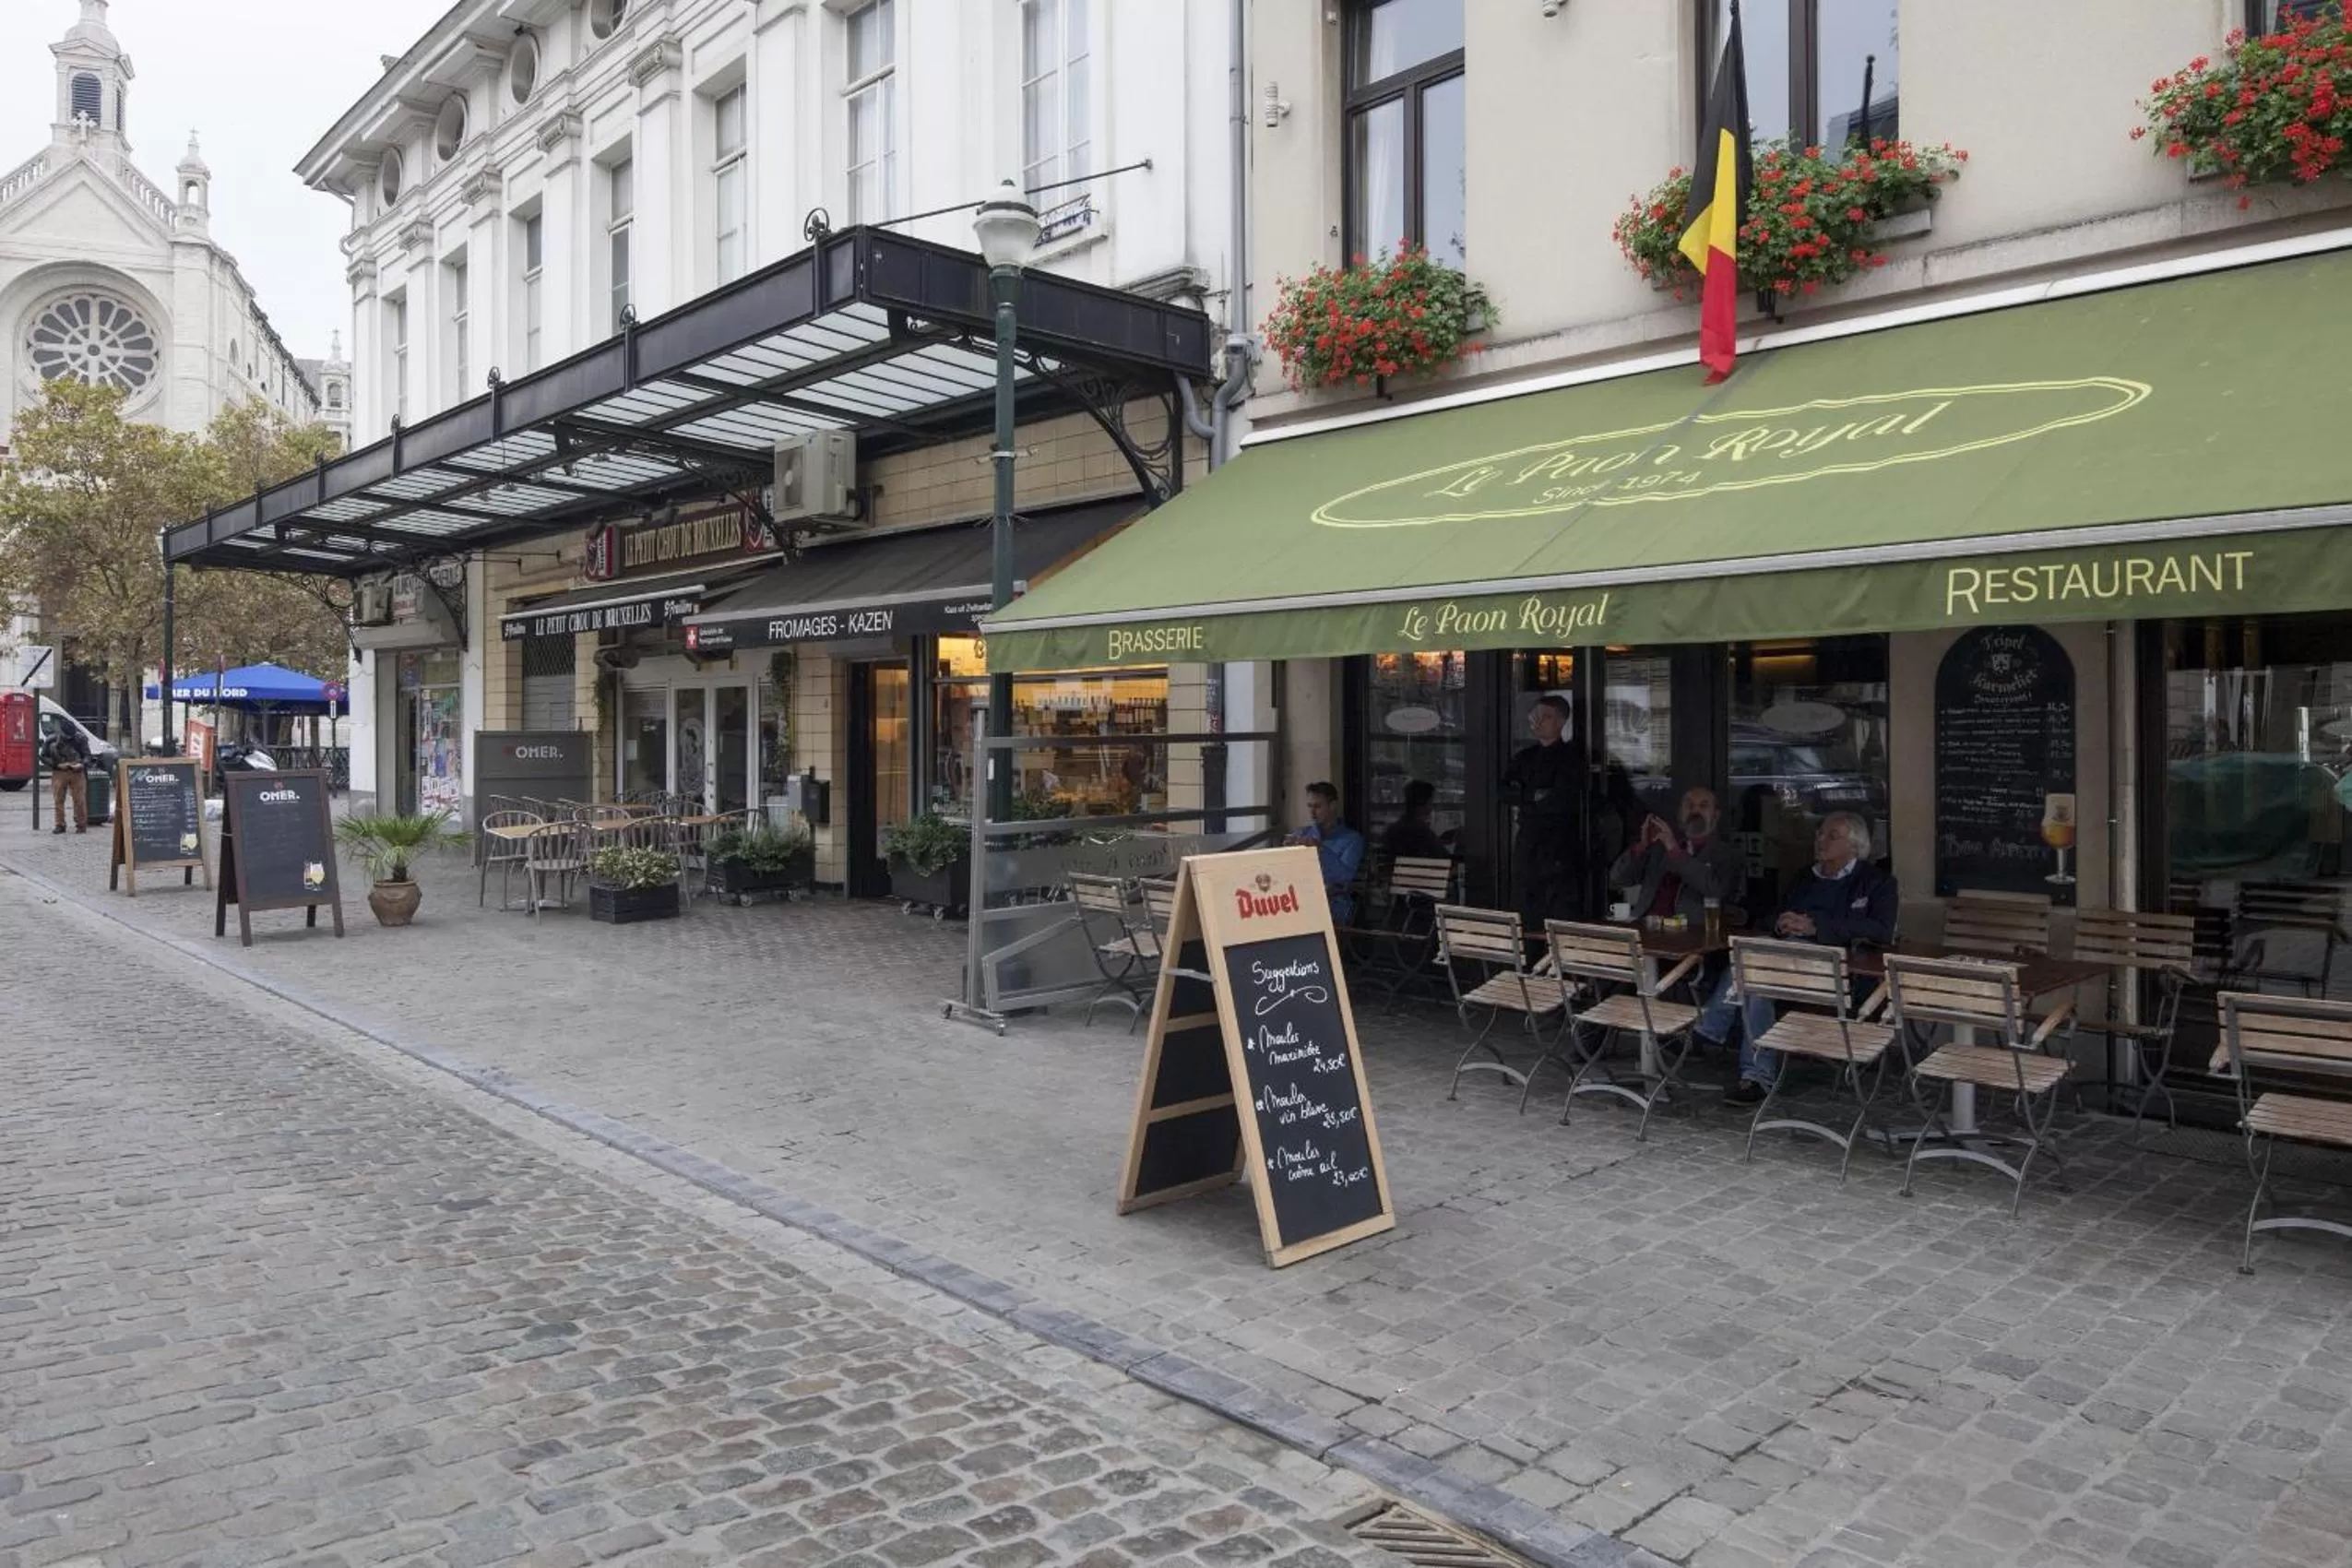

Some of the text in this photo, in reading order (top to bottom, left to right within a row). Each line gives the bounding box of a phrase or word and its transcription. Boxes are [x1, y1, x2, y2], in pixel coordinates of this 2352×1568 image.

[1422, 400, 1954, 497] Le Paon Royal
[1617, 469, 1702, 490] 1974
[635, 529, 656, 564] PETIT
[693, 511, 742, 555] BRUXELLES
[1946, 552, 2254, 616] RESTAURANT
[535, 602, 652, 636] LE PETIT CHOU DE BRUXELLES
[767, 615, 837, 640] FROMAGES
[848, 610, 894, 635] KAZEN
[1397, 592, 1610, 641] Le Paon Royal
[1108, 626, 1204, 660] BRASSERIE
[194, 688, 211, 698] DU
[1235, 885, 1300, 920] Duvel
[1252, 959, 1320, 992] Suggestions
[1278, 1109, 1297, 1125] vin
